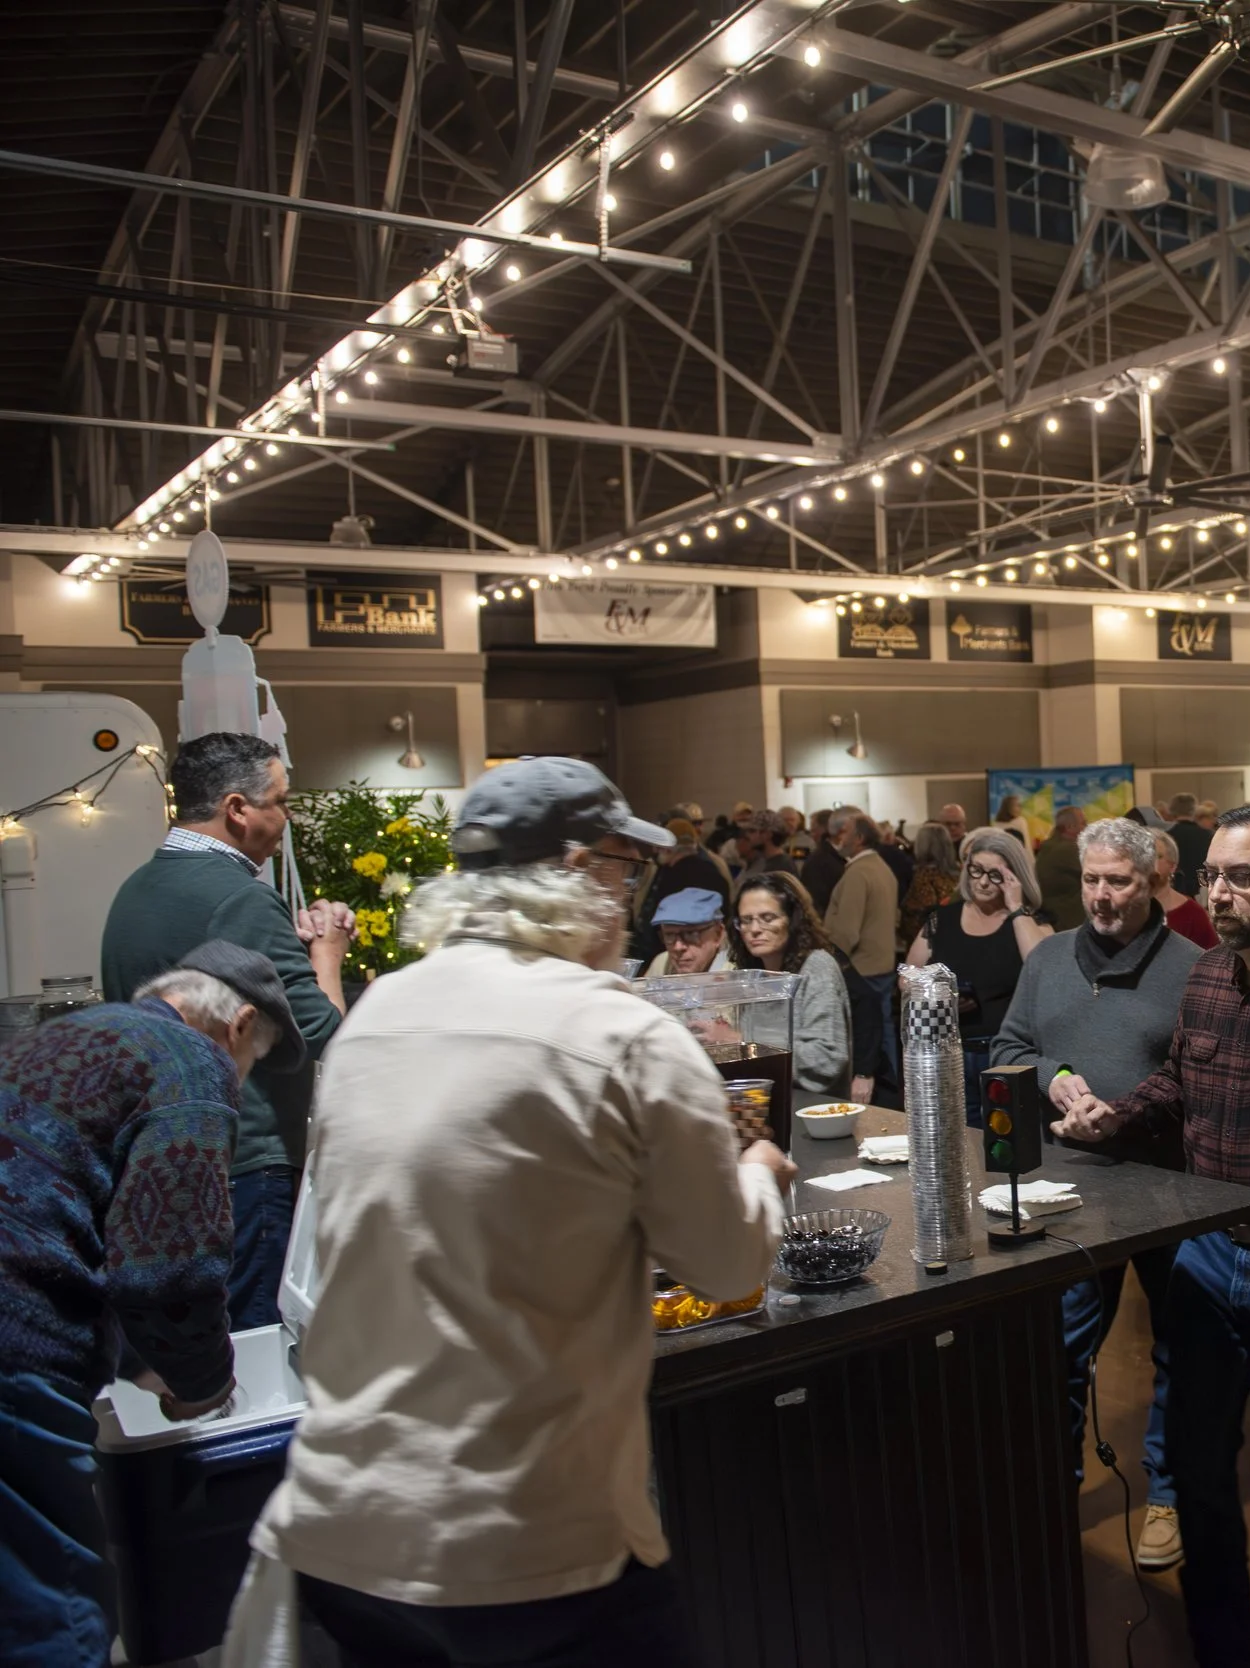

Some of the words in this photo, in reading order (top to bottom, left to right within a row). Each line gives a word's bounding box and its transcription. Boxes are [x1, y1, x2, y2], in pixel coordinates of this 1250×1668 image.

[366, 606, 436, 627] Bank
[317, 623, 365, 634] FARMERS
[376, 624, 437, 636] MERCHANTS
